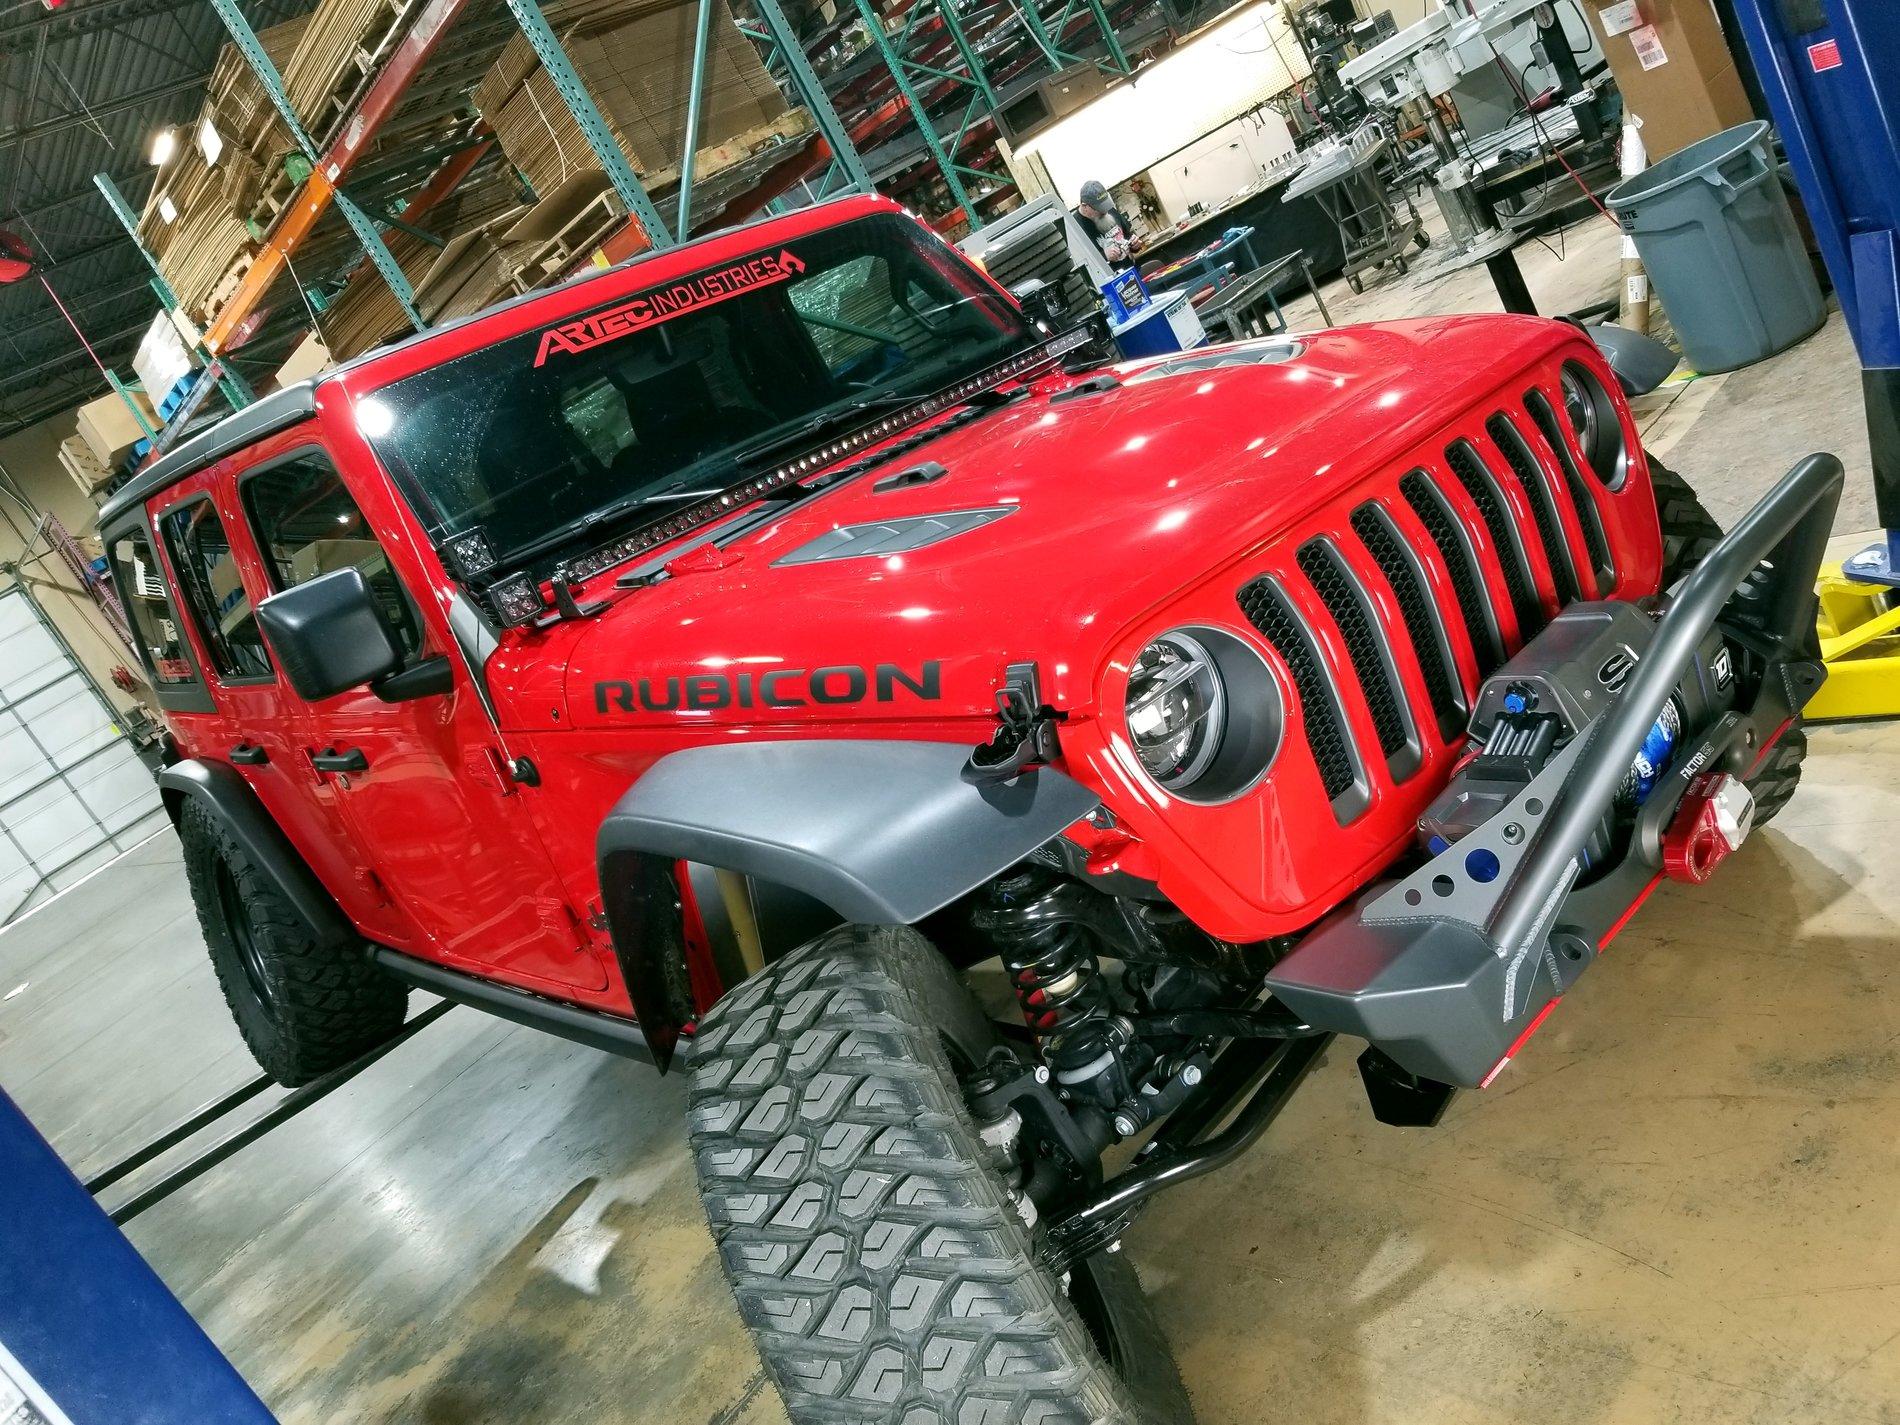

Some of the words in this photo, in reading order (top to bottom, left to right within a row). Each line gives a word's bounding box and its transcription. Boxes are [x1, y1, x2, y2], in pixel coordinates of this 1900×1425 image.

[533, 300, 654, 368] ARTEC
[651, 255, 782, 318] INDUSTRIES
[593, 660, 942, 713] RUBICON
[1680, 752, 1708, 781] FACTOR
